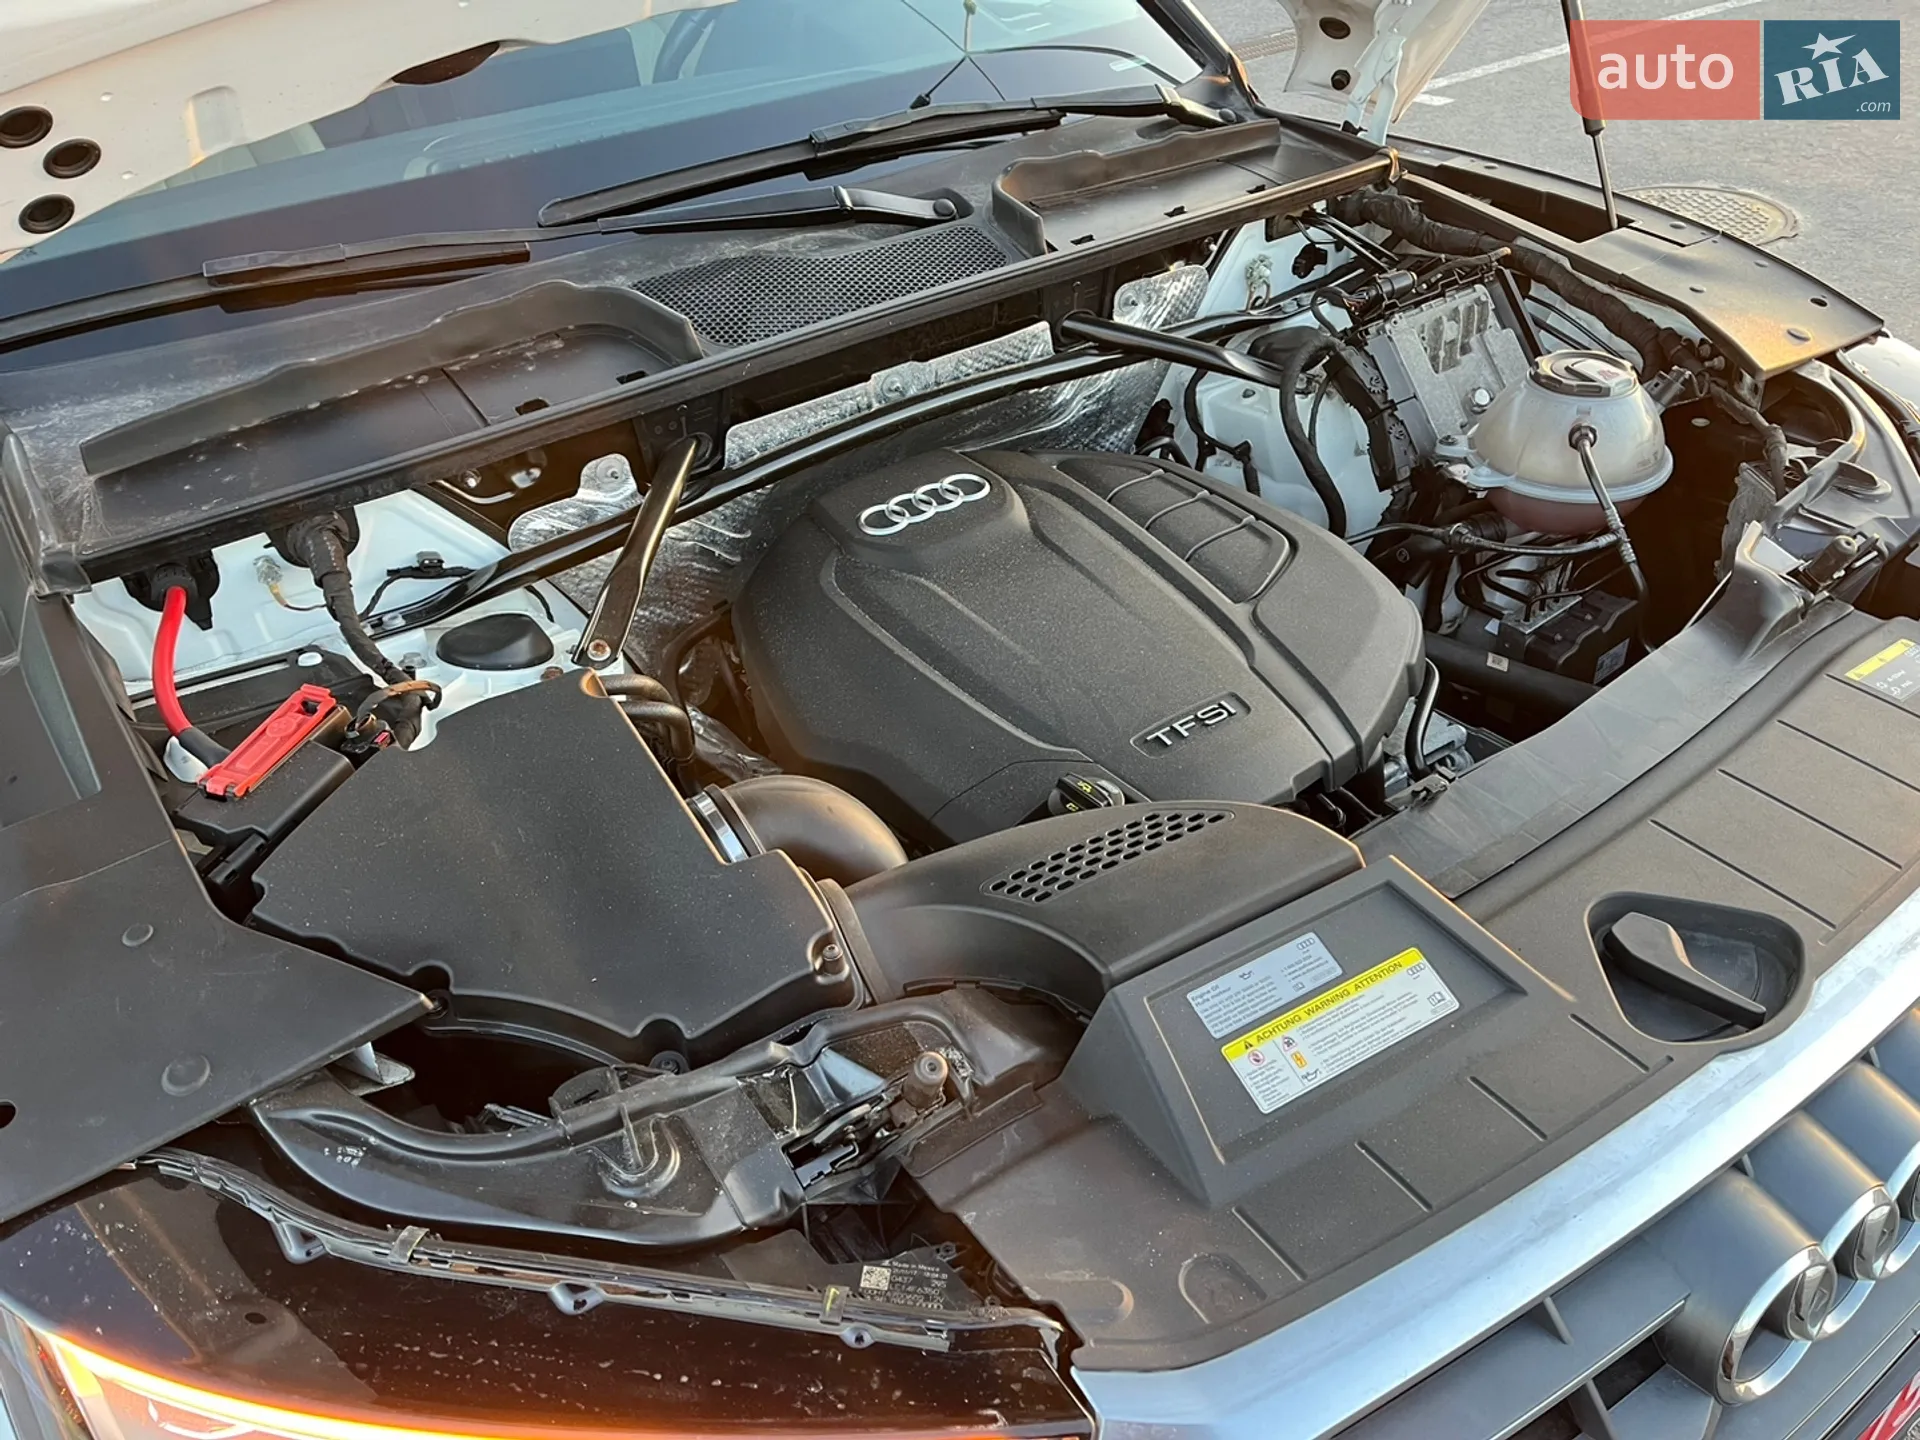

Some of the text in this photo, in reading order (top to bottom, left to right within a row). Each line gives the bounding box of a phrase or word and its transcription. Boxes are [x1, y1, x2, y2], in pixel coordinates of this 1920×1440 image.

[1146, 700, 1237, 746] TFSI
[1256, 1015, 1302, 1044] ACHTUNG
[1304, 989, 1351, 1017] WARNING
[1354, 961, 1404, 990] ATTENTION
